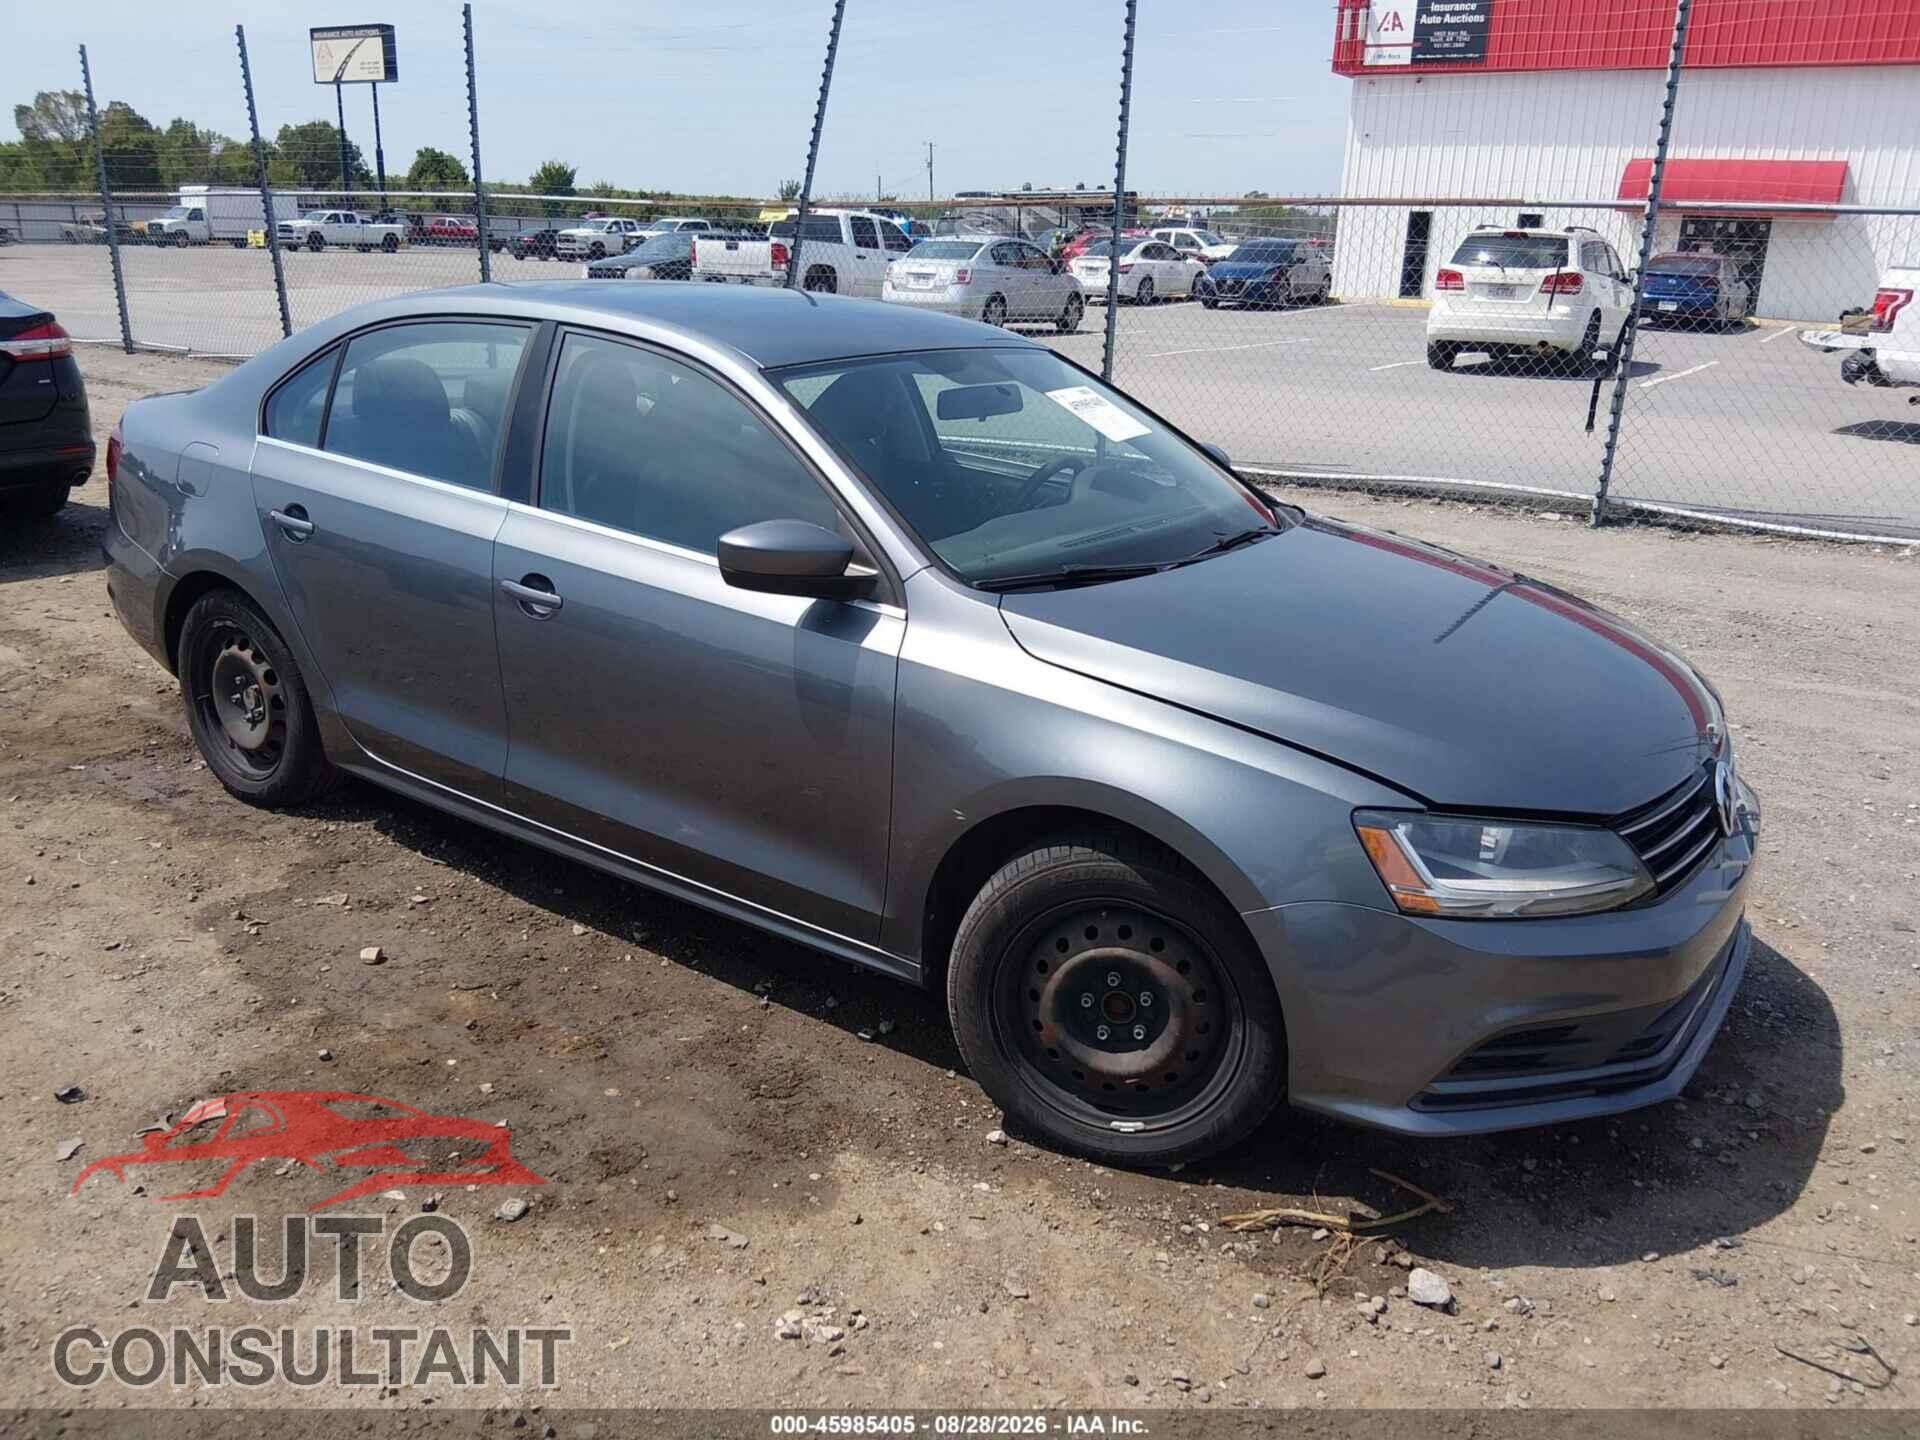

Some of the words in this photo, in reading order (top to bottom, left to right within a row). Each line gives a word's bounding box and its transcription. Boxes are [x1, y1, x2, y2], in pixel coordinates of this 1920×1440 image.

[1431, 2, 1477, 12] Insurance
[1420, 14, 1442, 25] Auto
[1443, 13, 1485, 24] Auctions
